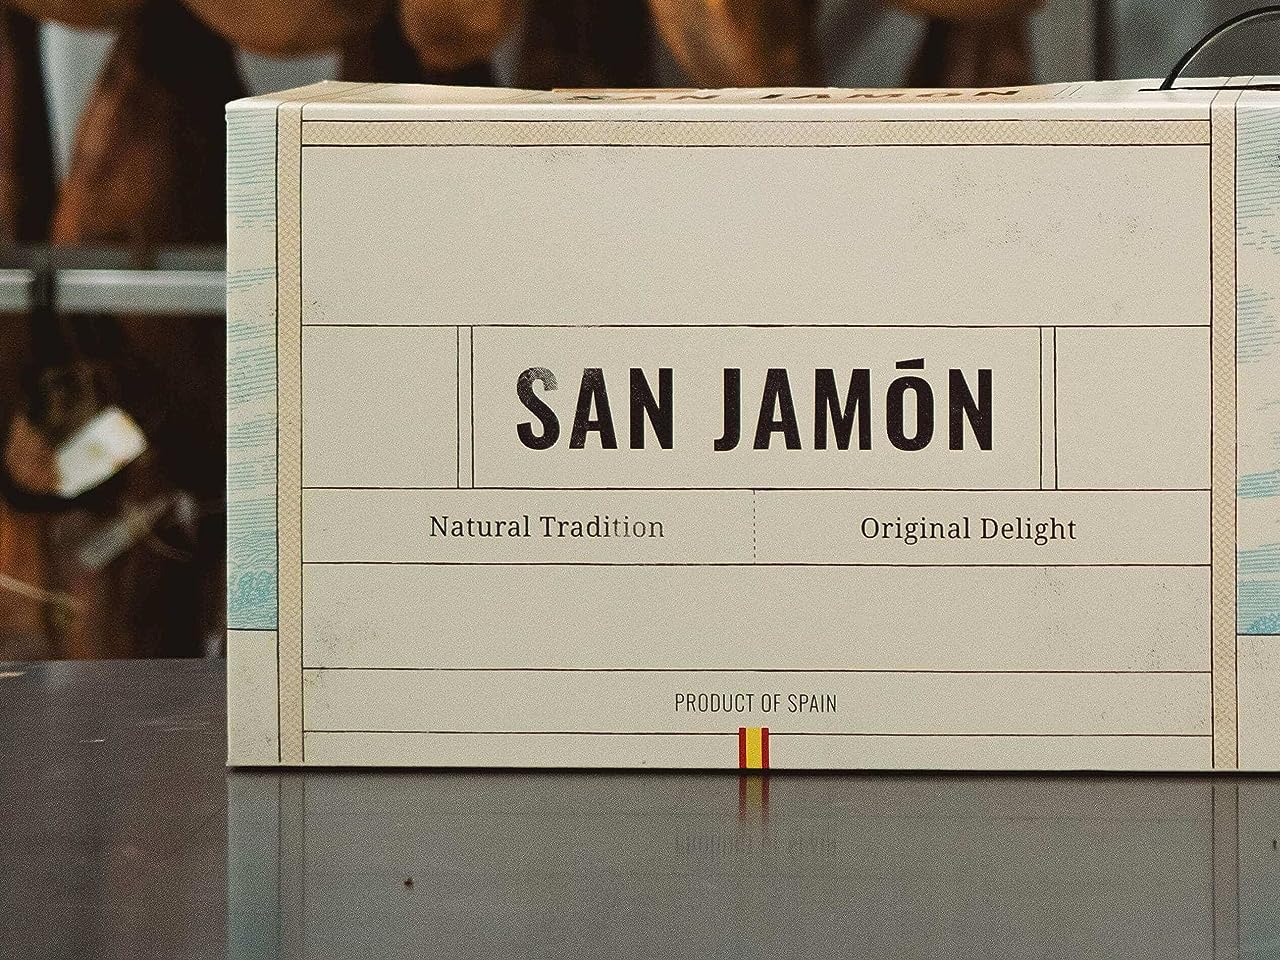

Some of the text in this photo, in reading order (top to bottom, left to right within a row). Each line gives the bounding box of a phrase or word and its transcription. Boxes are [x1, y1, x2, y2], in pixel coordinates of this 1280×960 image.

[517, 358, 992, 451] SAN JAMÓN
[430, 515, 663, 537] Natural Tradition
[861, 517, 1075, 545] Original Delight
[676, 693, 836, 712] PRODUCT OF SPAIN
